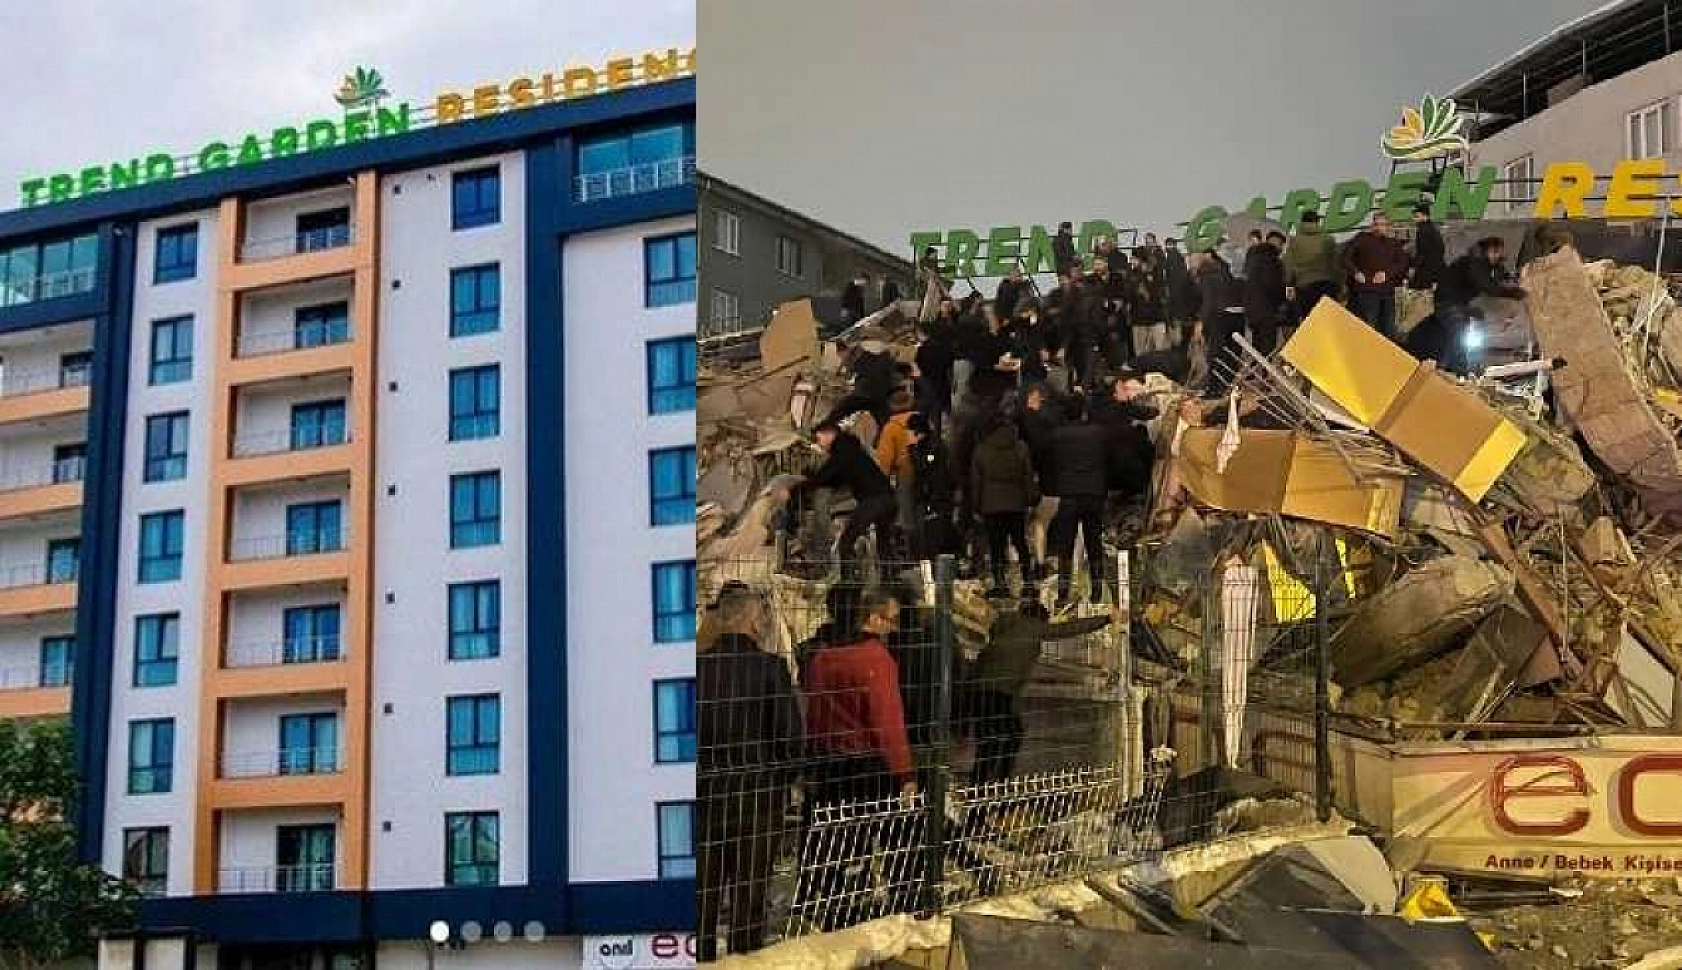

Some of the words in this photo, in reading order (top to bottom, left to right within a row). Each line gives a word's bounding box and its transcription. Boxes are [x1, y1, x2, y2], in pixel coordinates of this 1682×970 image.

[20, 153, 174, 205] TREND
[199, 102, 411, 170] GARDEN
[1533, 158, 1682, 222] RE
[1485, 854, 1534, 869] Anne
[1554, 854, 1614, 871] Bebek
